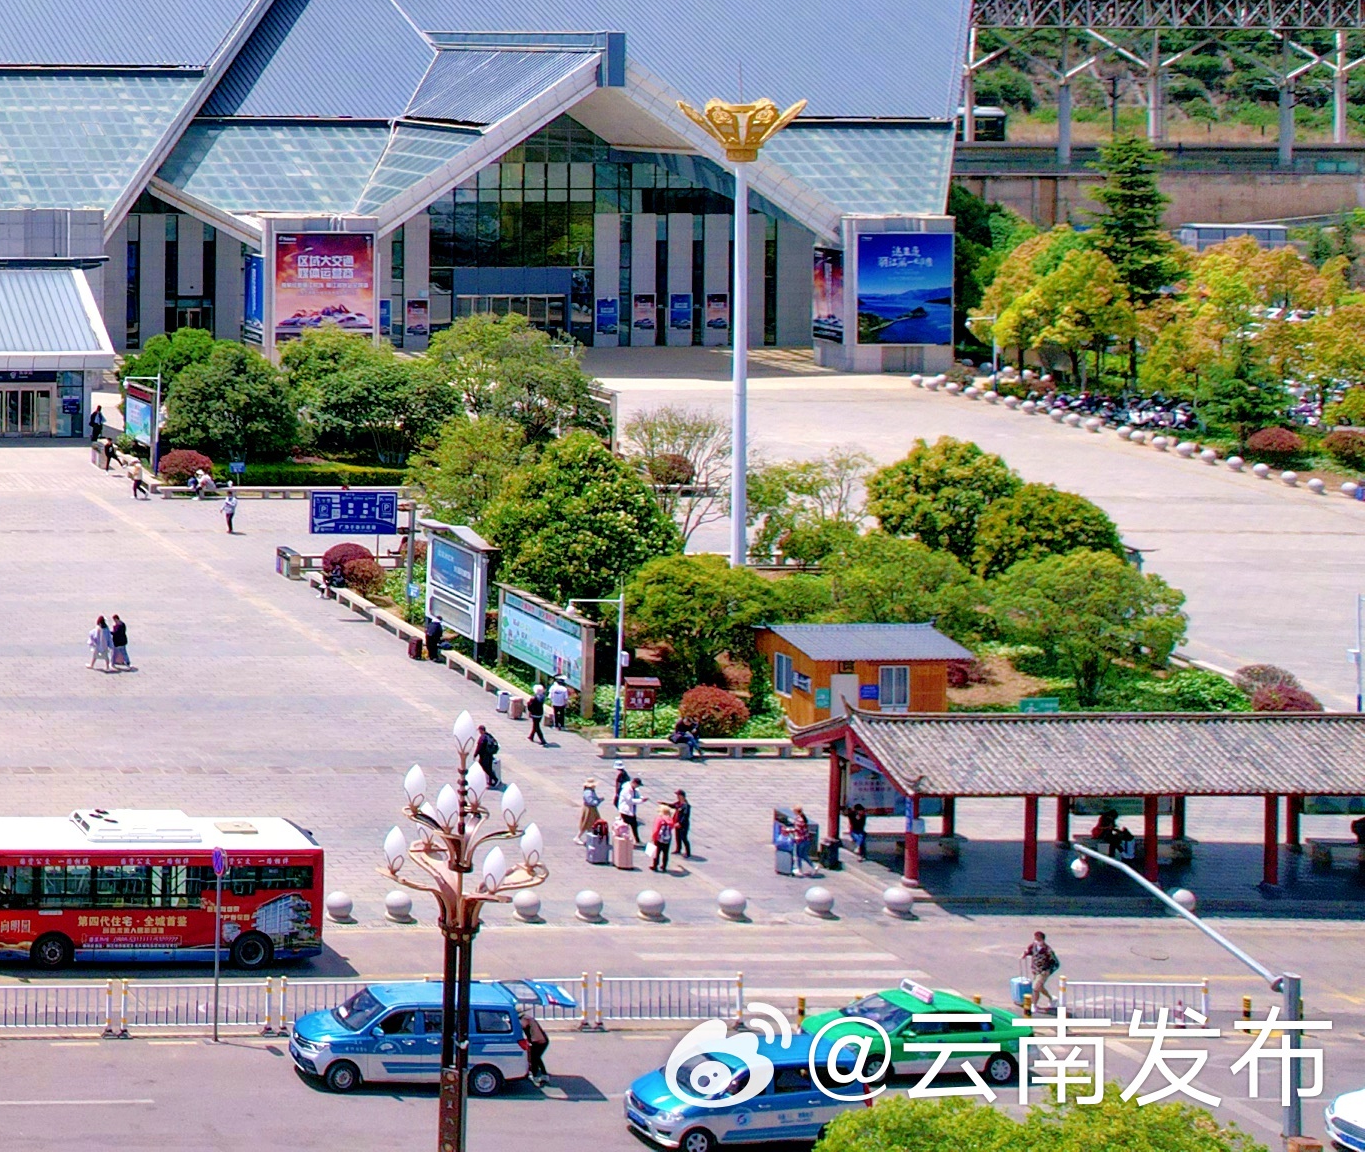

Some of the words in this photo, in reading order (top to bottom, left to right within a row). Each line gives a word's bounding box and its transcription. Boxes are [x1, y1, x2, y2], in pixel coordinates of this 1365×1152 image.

[297, 255, 354, 267] 区域大交通
